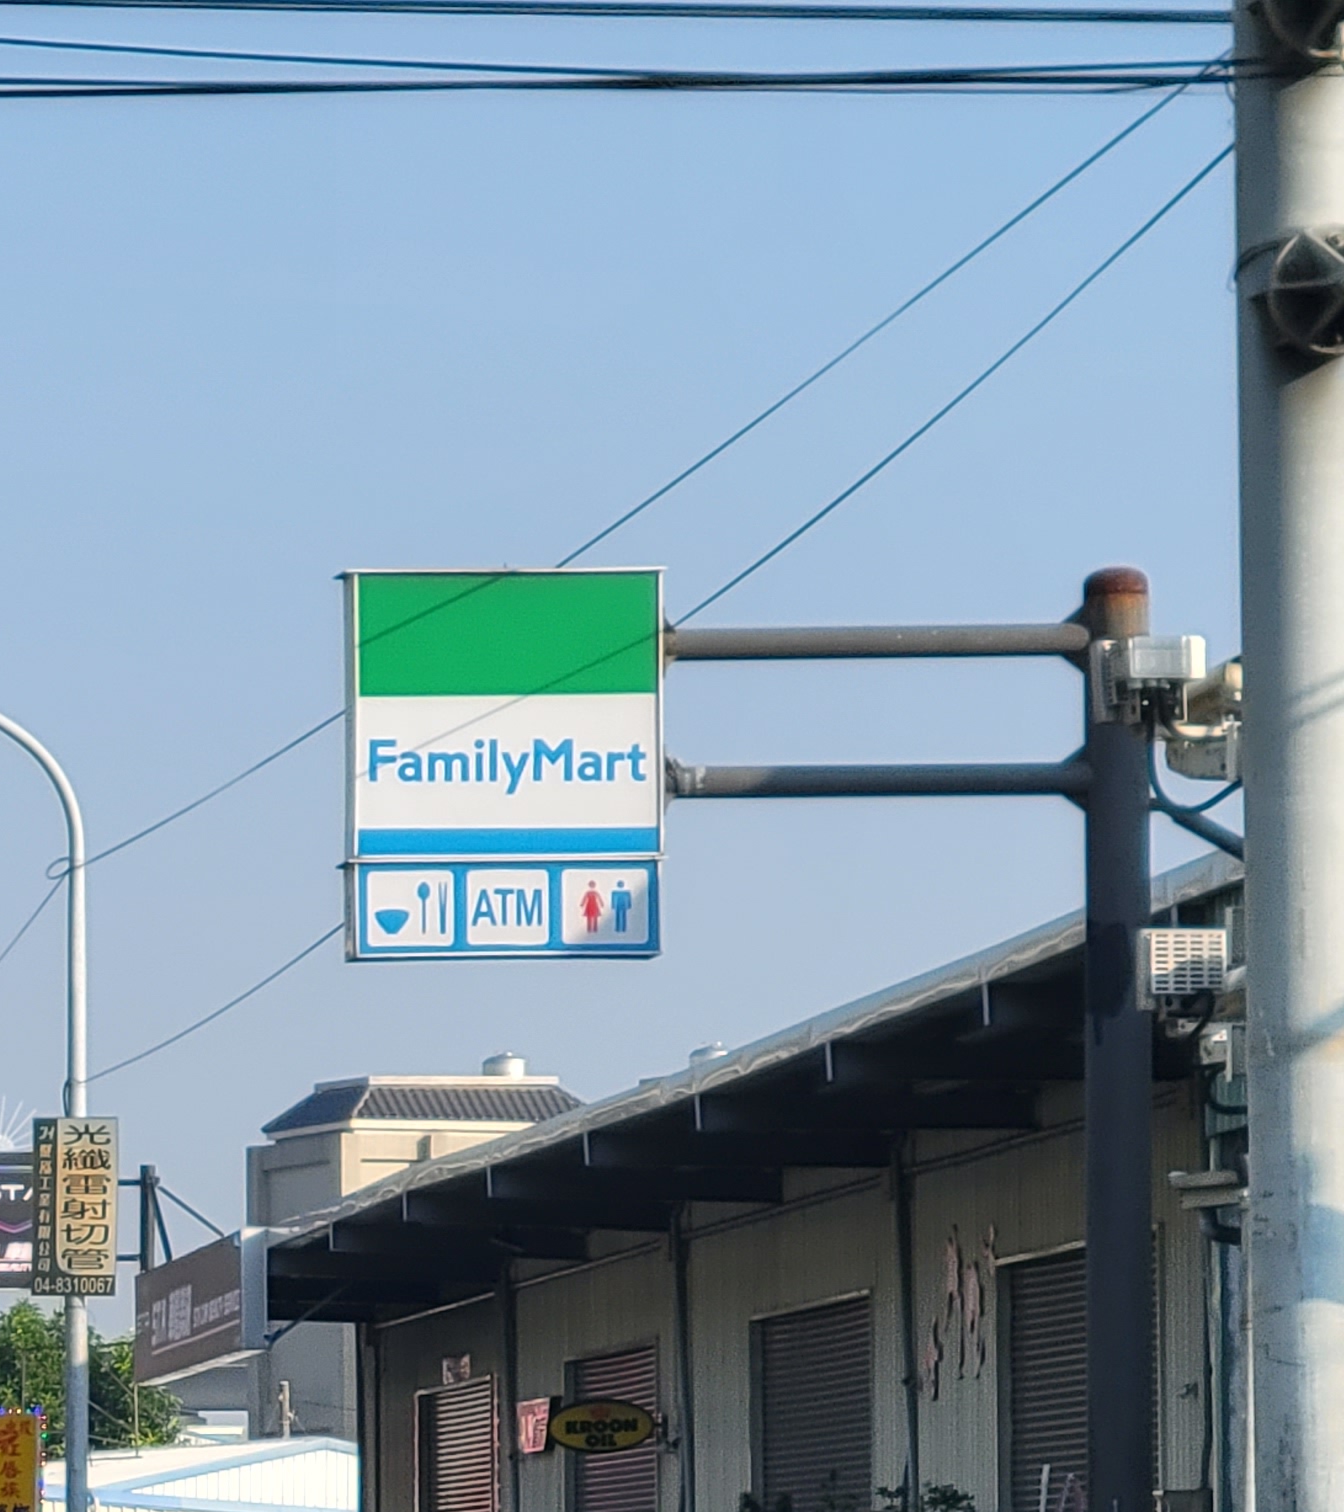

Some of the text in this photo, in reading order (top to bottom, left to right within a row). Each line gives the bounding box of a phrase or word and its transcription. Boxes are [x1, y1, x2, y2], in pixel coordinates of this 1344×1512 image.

[368, 739, 647, 795] FamilyMart
[472, 888, 543, 927] ATM
[34, 1276, 112, 1293] 04-8310067
[564, 1419, 639, 1434] KROON
[584, 1433, 617, 1447] OIL
